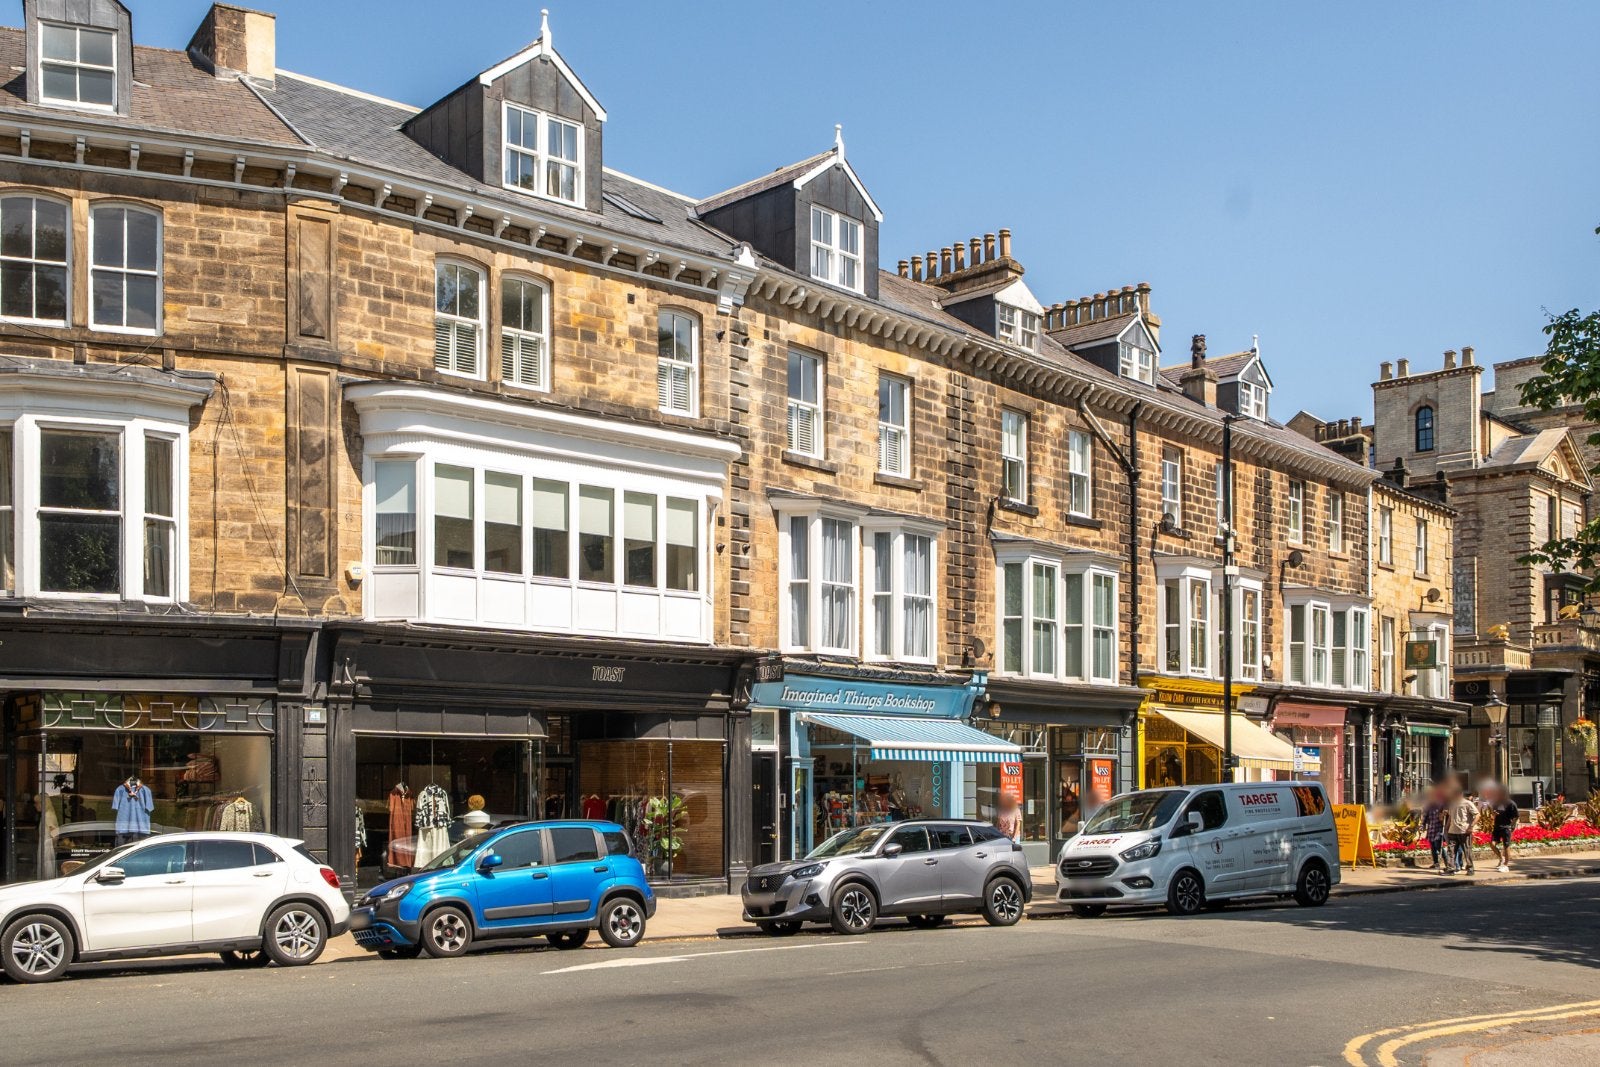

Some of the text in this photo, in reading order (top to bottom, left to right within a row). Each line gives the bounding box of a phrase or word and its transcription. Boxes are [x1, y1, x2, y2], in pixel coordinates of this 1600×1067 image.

[592, 666, 626, 682] TOAST
[755, 664, 782, 681] TOAST
[781, 686, 936, 713] Imagined Things Bookshop
[932, 761, 942, 807] OOKS
[1239, 793, 1278, 805] TARGET
[1077, 838, 1121, 846] TARGET
